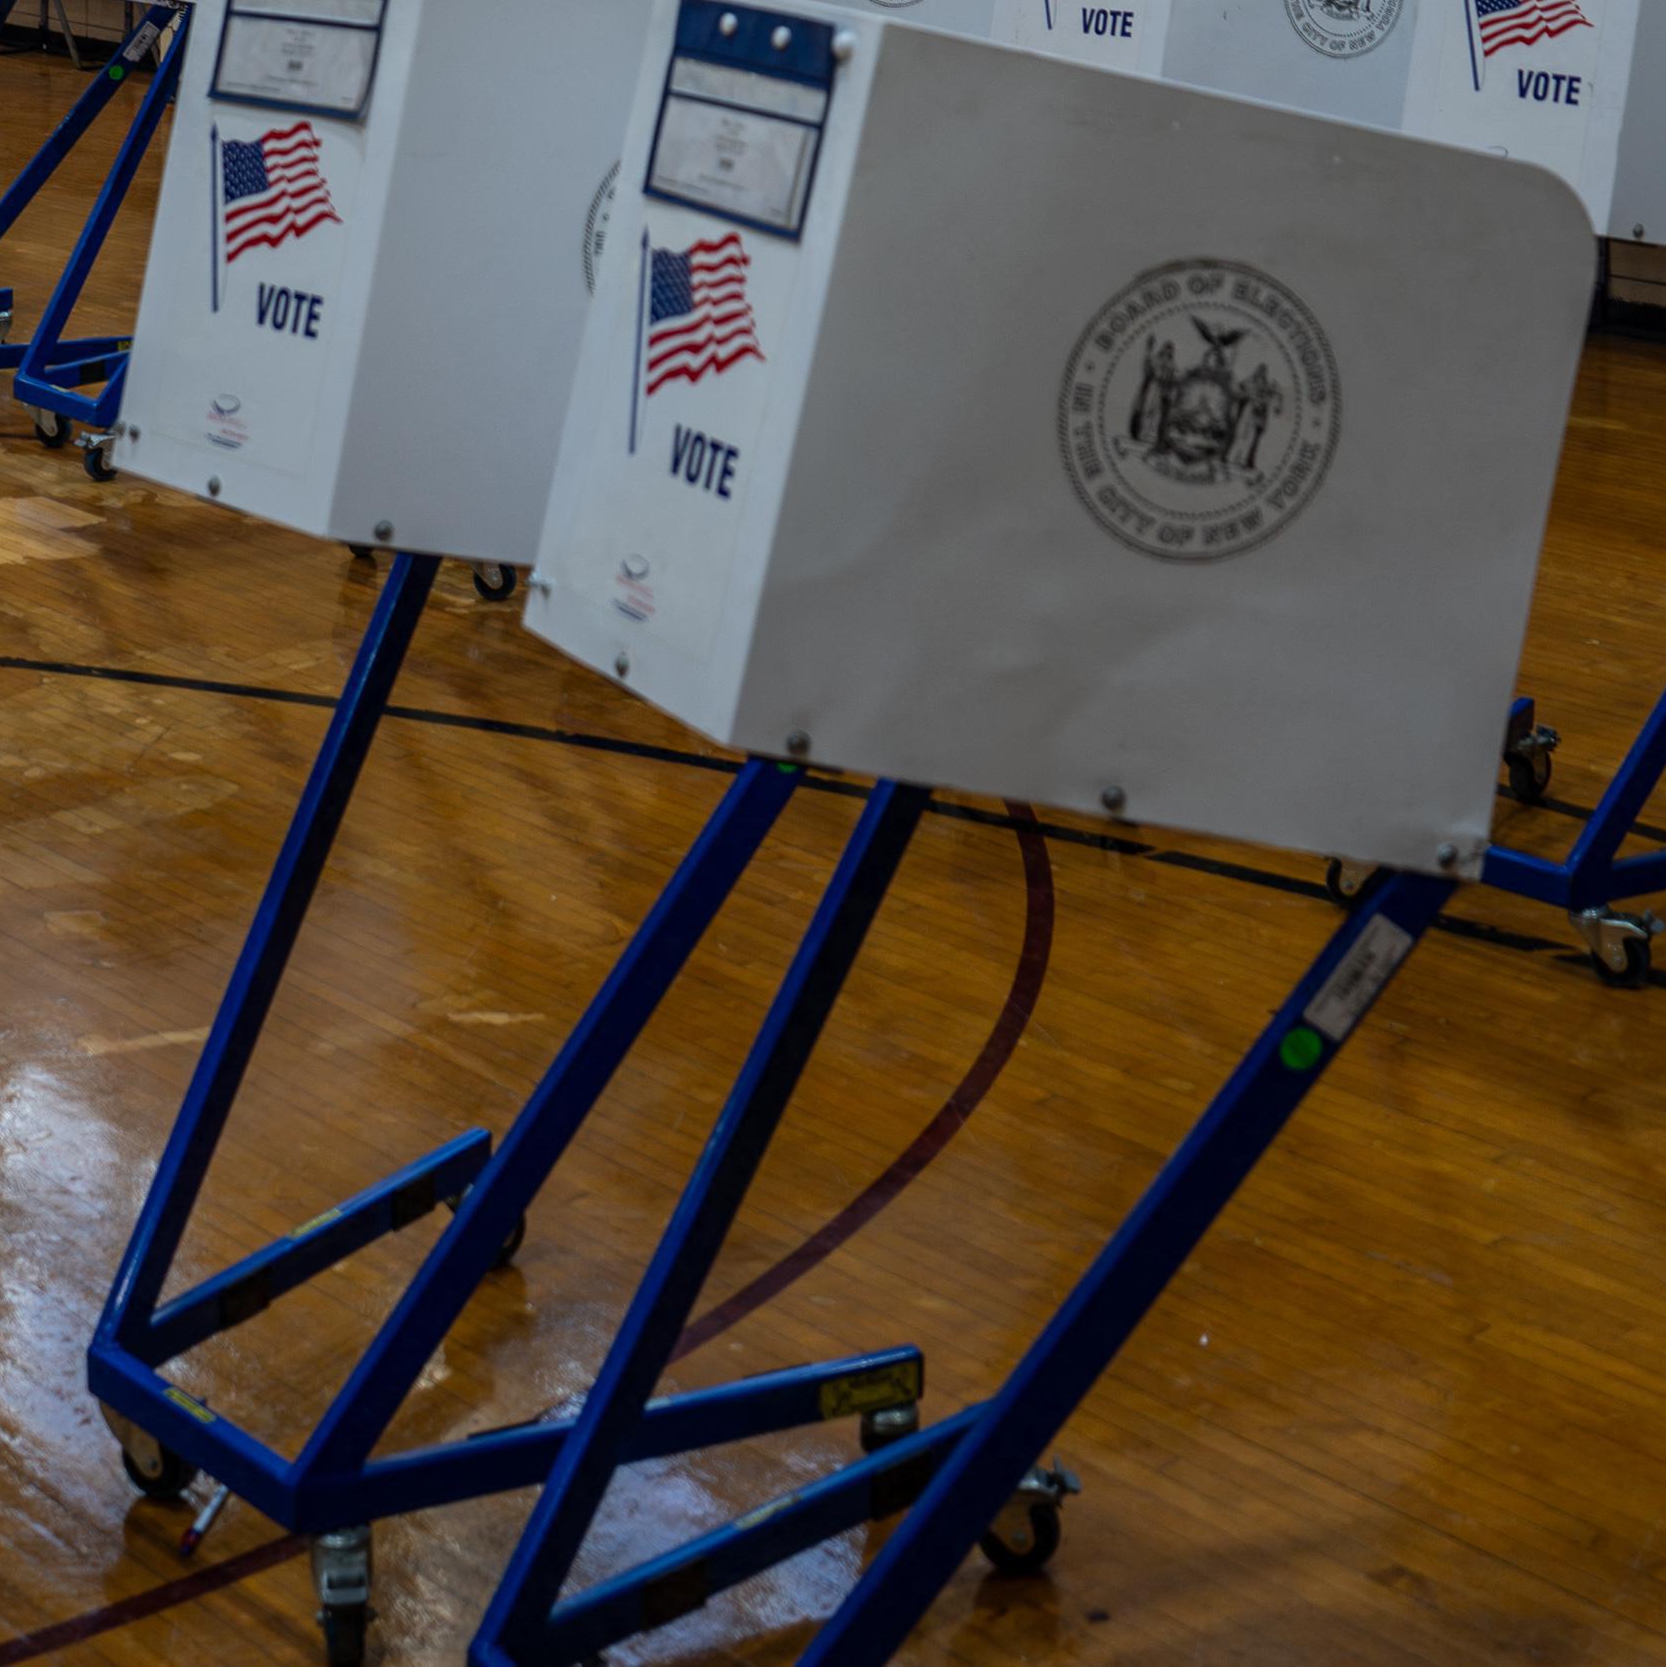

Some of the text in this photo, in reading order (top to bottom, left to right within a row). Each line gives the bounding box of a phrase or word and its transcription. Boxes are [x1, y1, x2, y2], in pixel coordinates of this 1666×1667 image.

[1081, 7, 1134, 38] VOTE
[1302, 22, 1329, 46] CITY
[1329, 40, 1346, 51] OF
[1349, 30, 1376, 51] NEW
[1517, 68, 1582, 106] VOTE
[257, 282, 323, 339] VOTE
[1094, 274, 1326, 405] BOARD OF ELECTIONS
[1073, 382, 1094, 412] IN
[671, 423, 740, 502] VOTE
[1075, 421, 1103, 480] THE
[1265, 439, 1321, 511] YORK
[1097, 486, 1155, 533] CITY
[1202, 506, 1264, 545] NEW
[1159, 525, 1195, 544] OF
